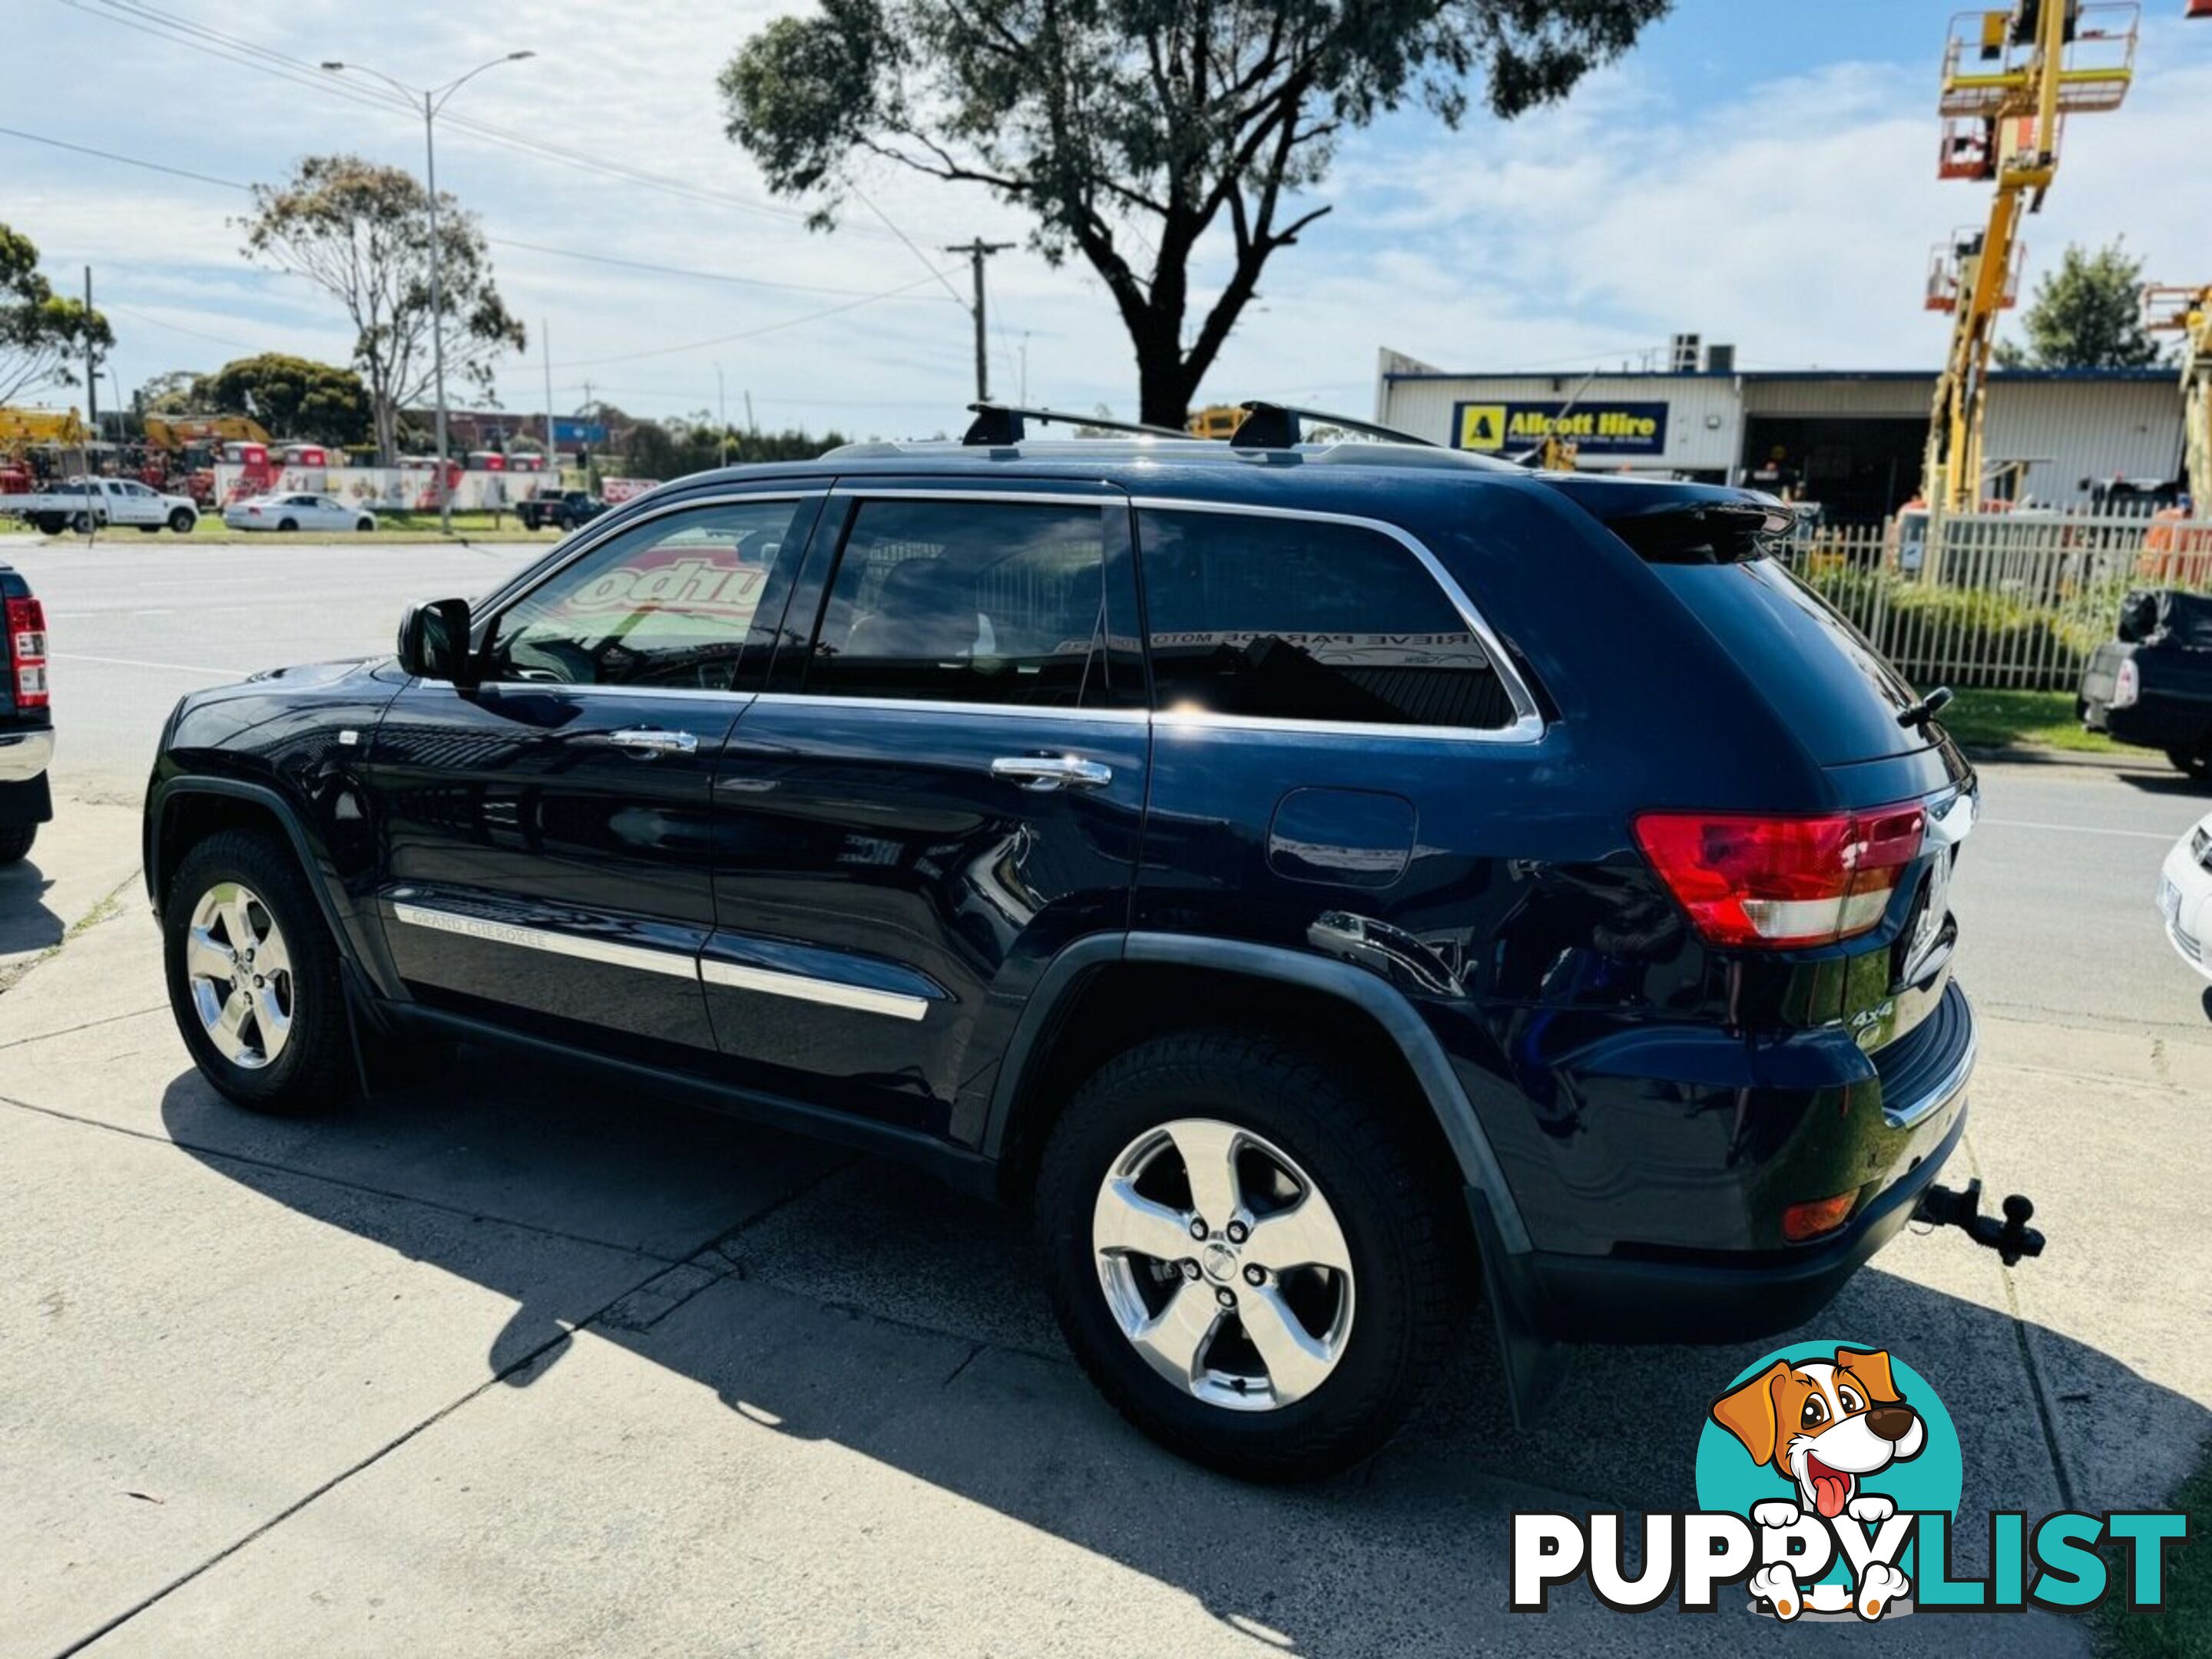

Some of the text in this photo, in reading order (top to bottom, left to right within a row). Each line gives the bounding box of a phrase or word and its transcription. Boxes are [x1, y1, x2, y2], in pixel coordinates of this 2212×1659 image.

[1508, 412, 1657, 435] Allcott Hire
[605, 480, 659, 500] cole
[412, 911, 547, 947] GRAND CHEROKEE
[1852, 1001, 1893, 1026] 4x4
